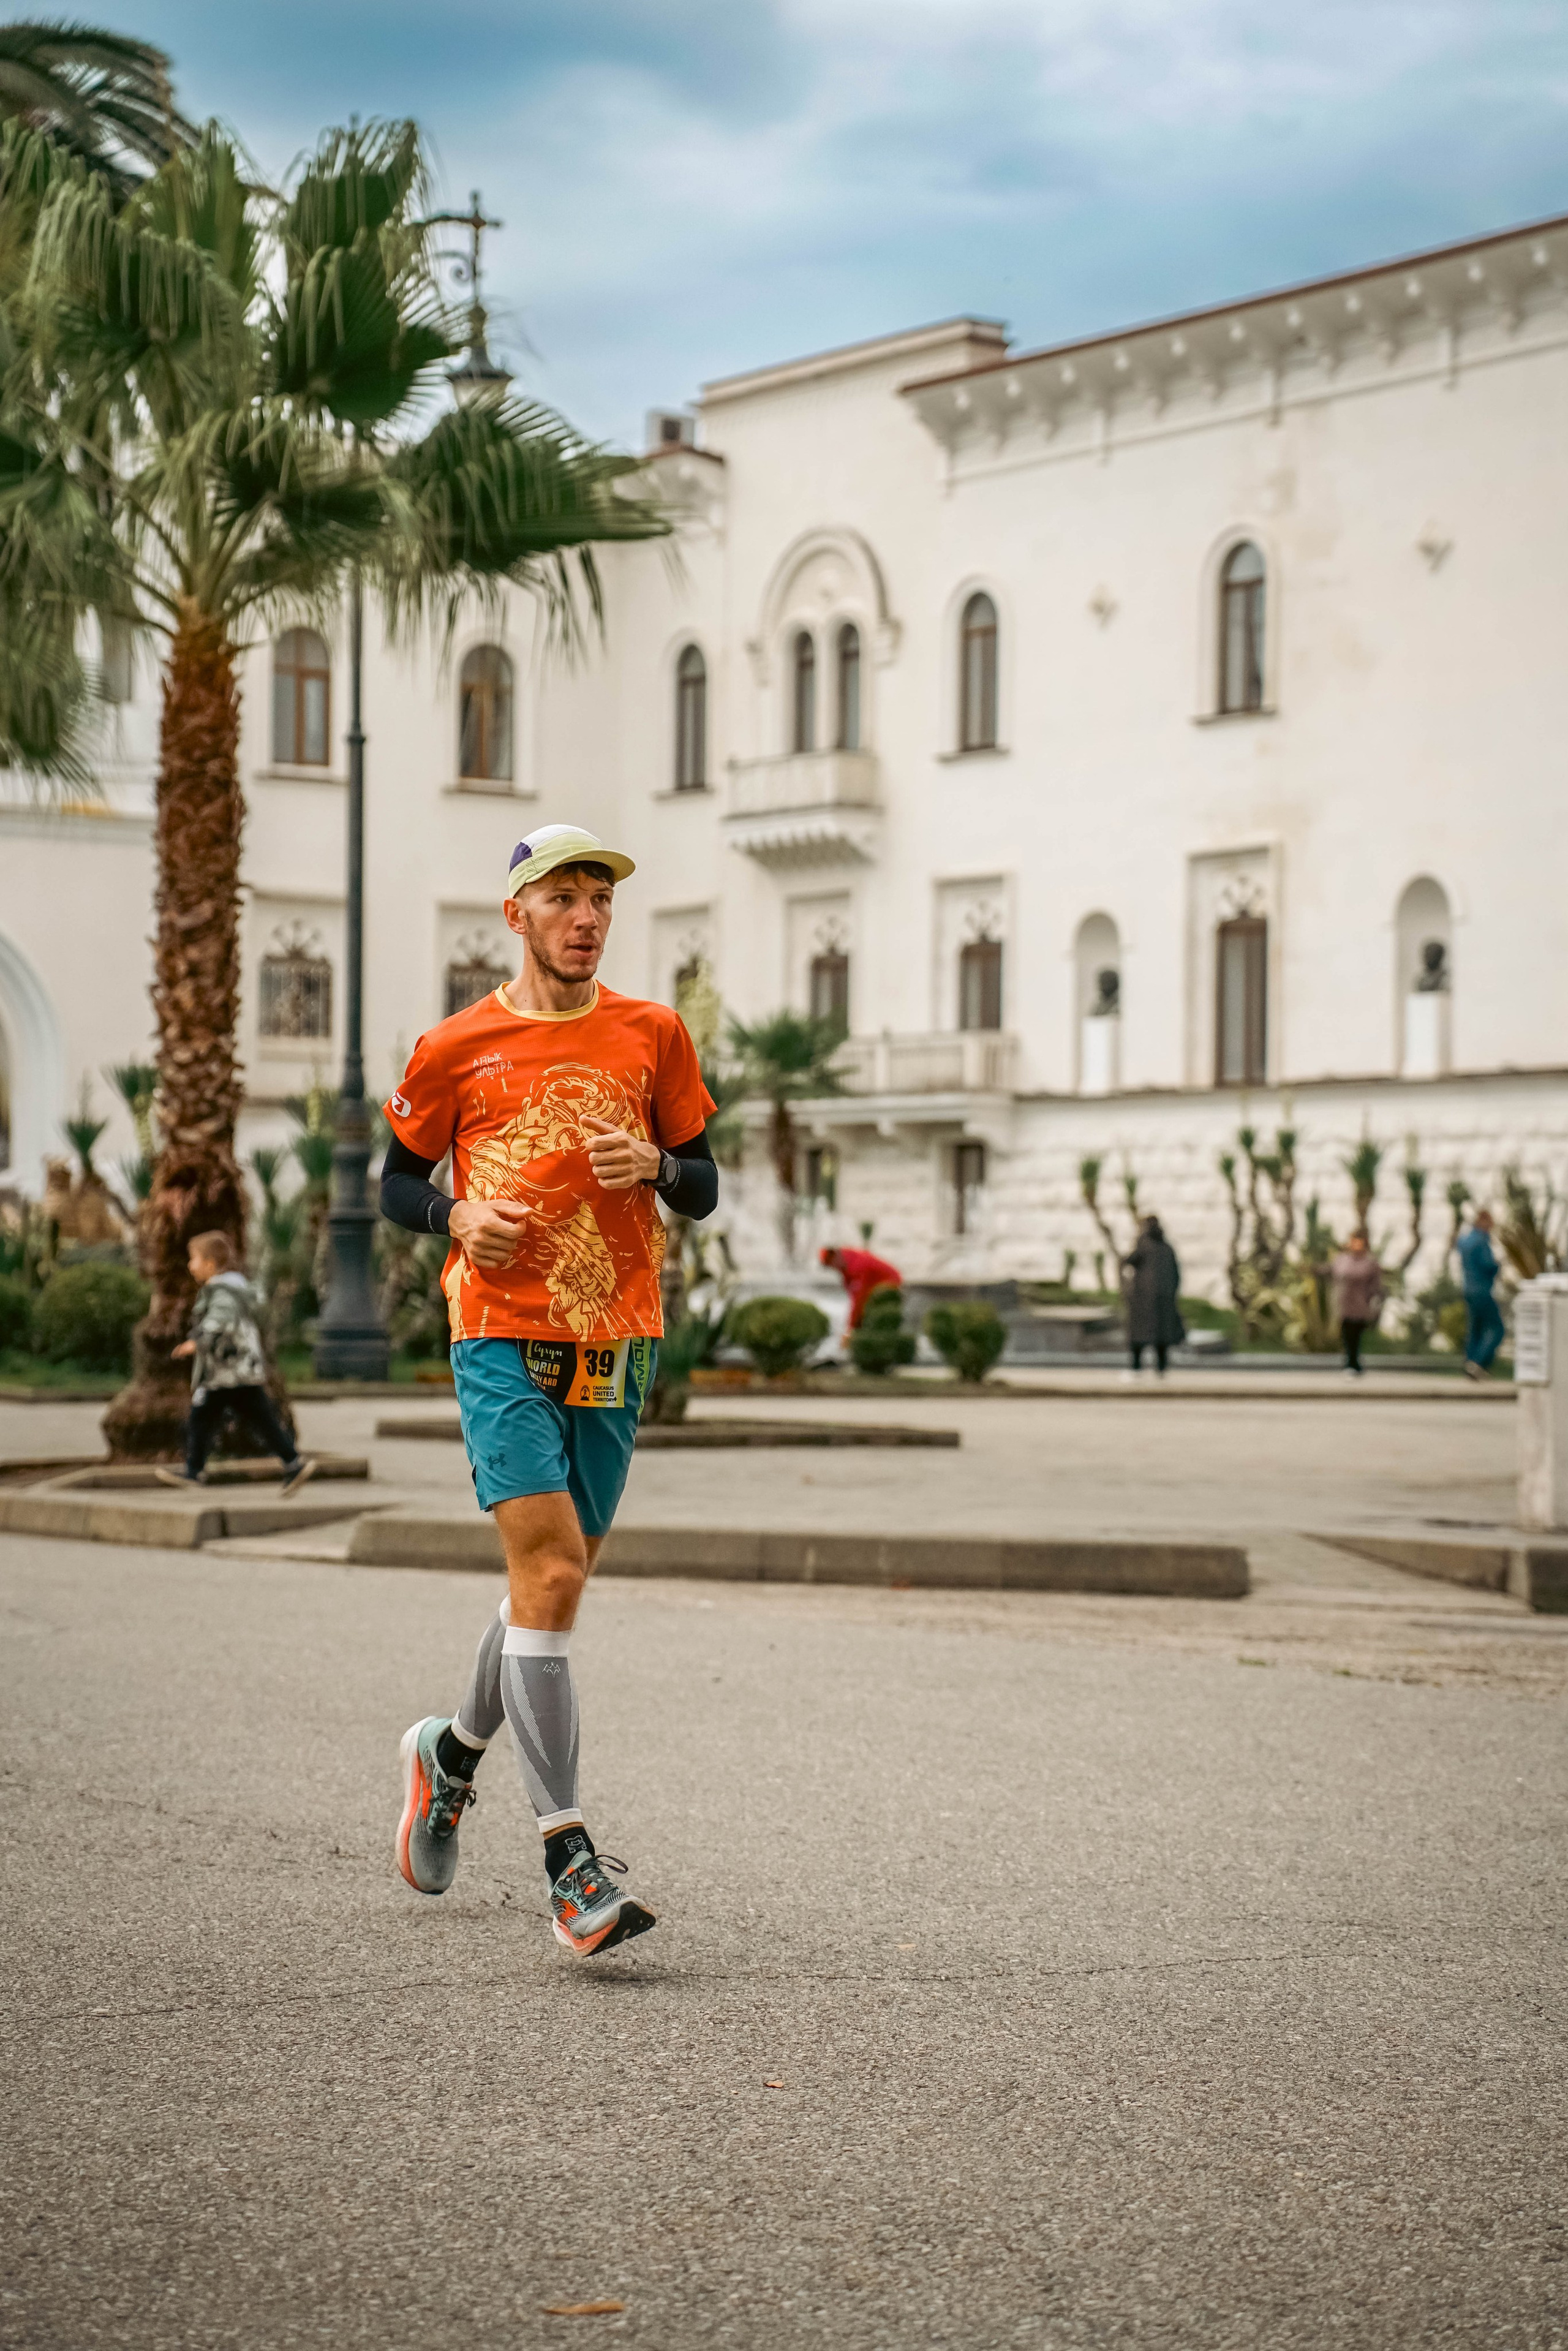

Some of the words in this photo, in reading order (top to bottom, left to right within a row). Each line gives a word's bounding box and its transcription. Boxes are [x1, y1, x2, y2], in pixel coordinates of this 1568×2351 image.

[475, 1060, 514, 1079] УЛЬТРА
[526, 1357, 560, 1375] WORLD
[584, 1349, 615, 1377] 39
